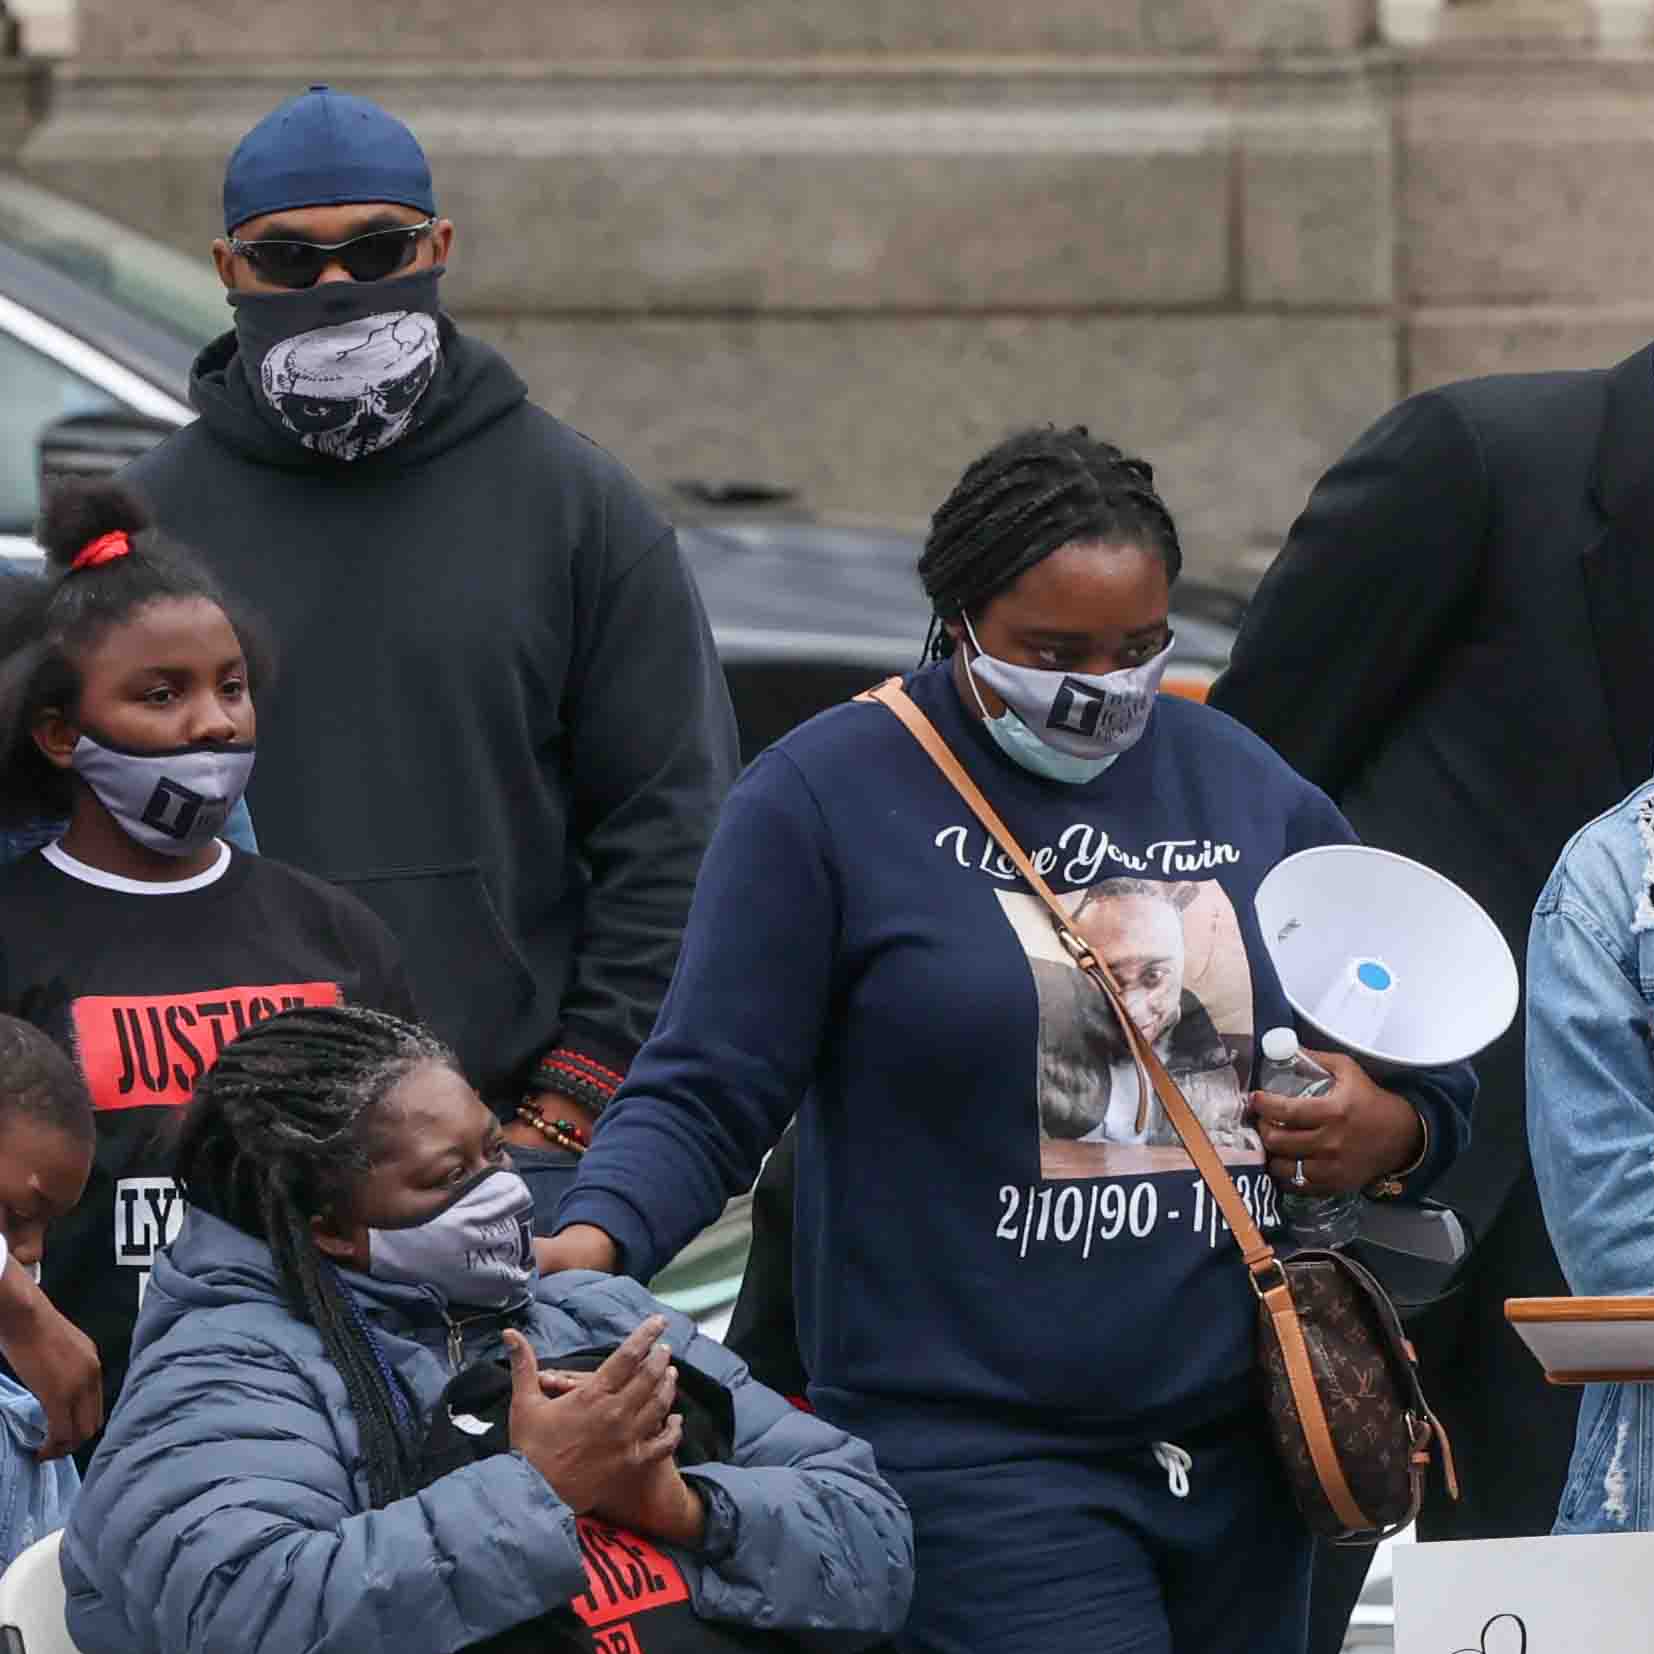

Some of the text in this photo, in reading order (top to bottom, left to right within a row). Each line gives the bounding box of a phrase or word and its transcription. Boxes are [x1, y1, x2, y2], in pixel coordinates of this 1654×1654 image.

[980, 833, 1057, 879] Loe
[1059, 823, 1147, 885] You
[1147, 839, 1240, 875] Twin
[996, 1182, 1158, 1259] 2/10/90
